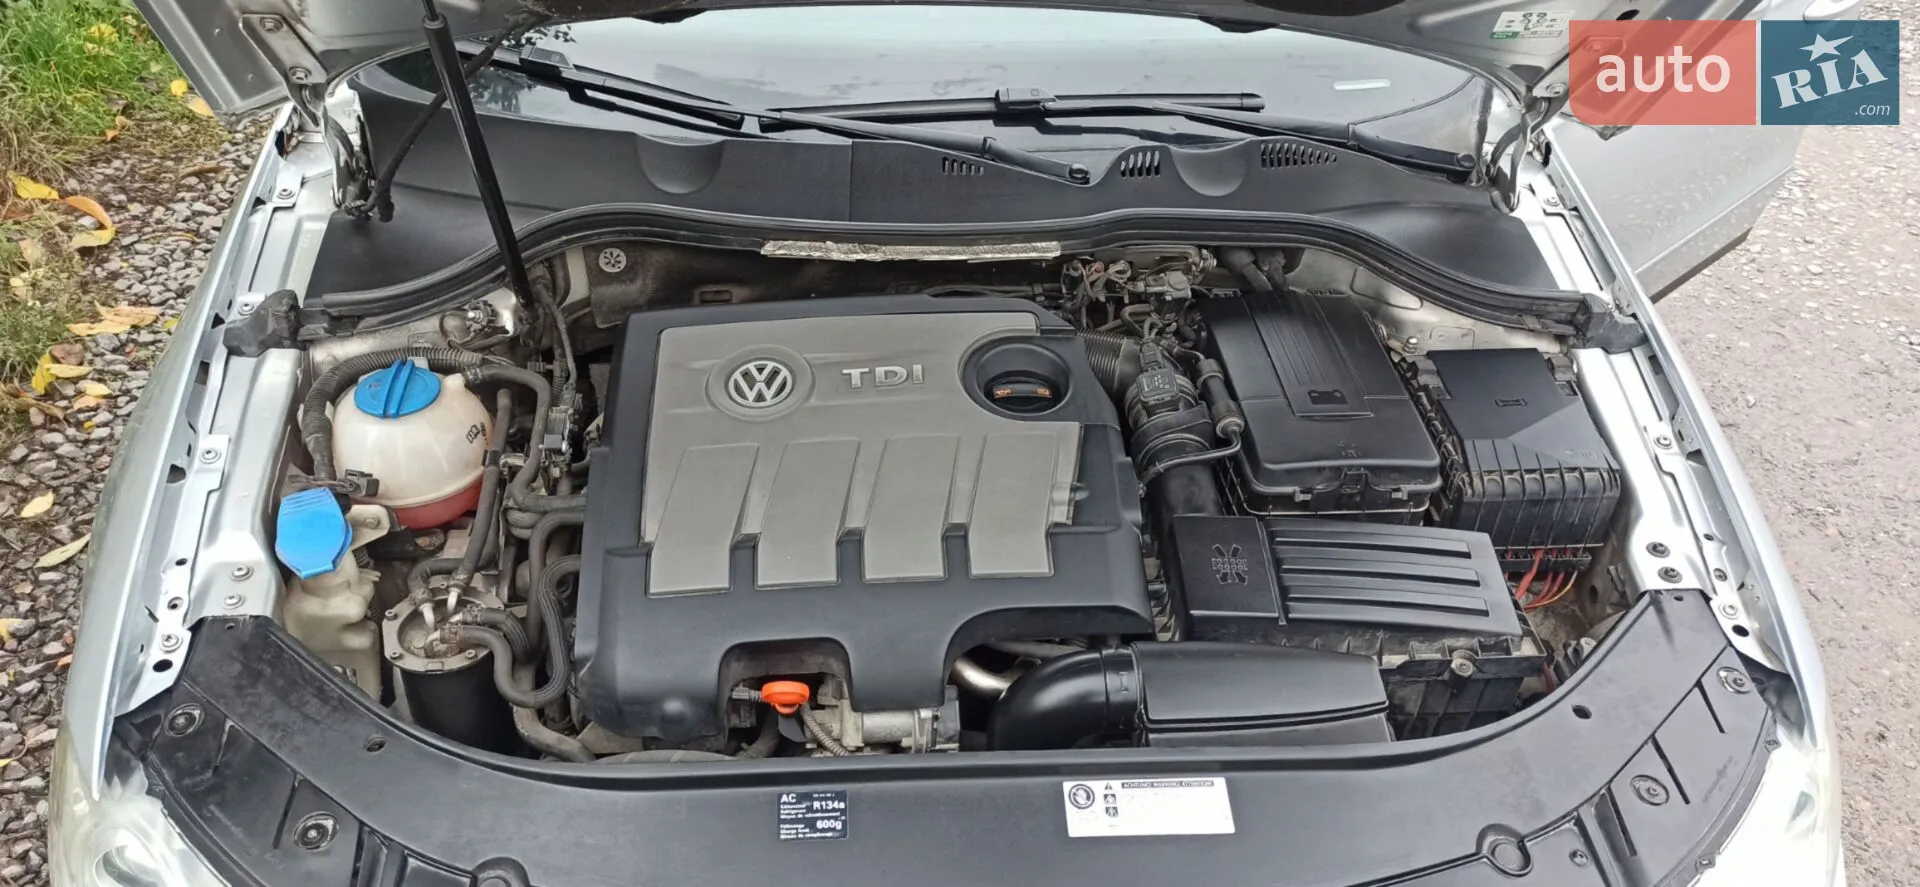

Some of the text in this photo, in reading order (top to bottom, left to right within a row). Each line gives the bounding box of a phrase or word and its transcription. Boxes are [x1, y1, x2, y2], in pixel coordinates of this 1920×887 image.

[729, 361, 925, 408] VW TDI
[780, 794, 796, 803] AC
[812, 800, 845, 810] R134a
[816, 819, 842, 830] 600g
